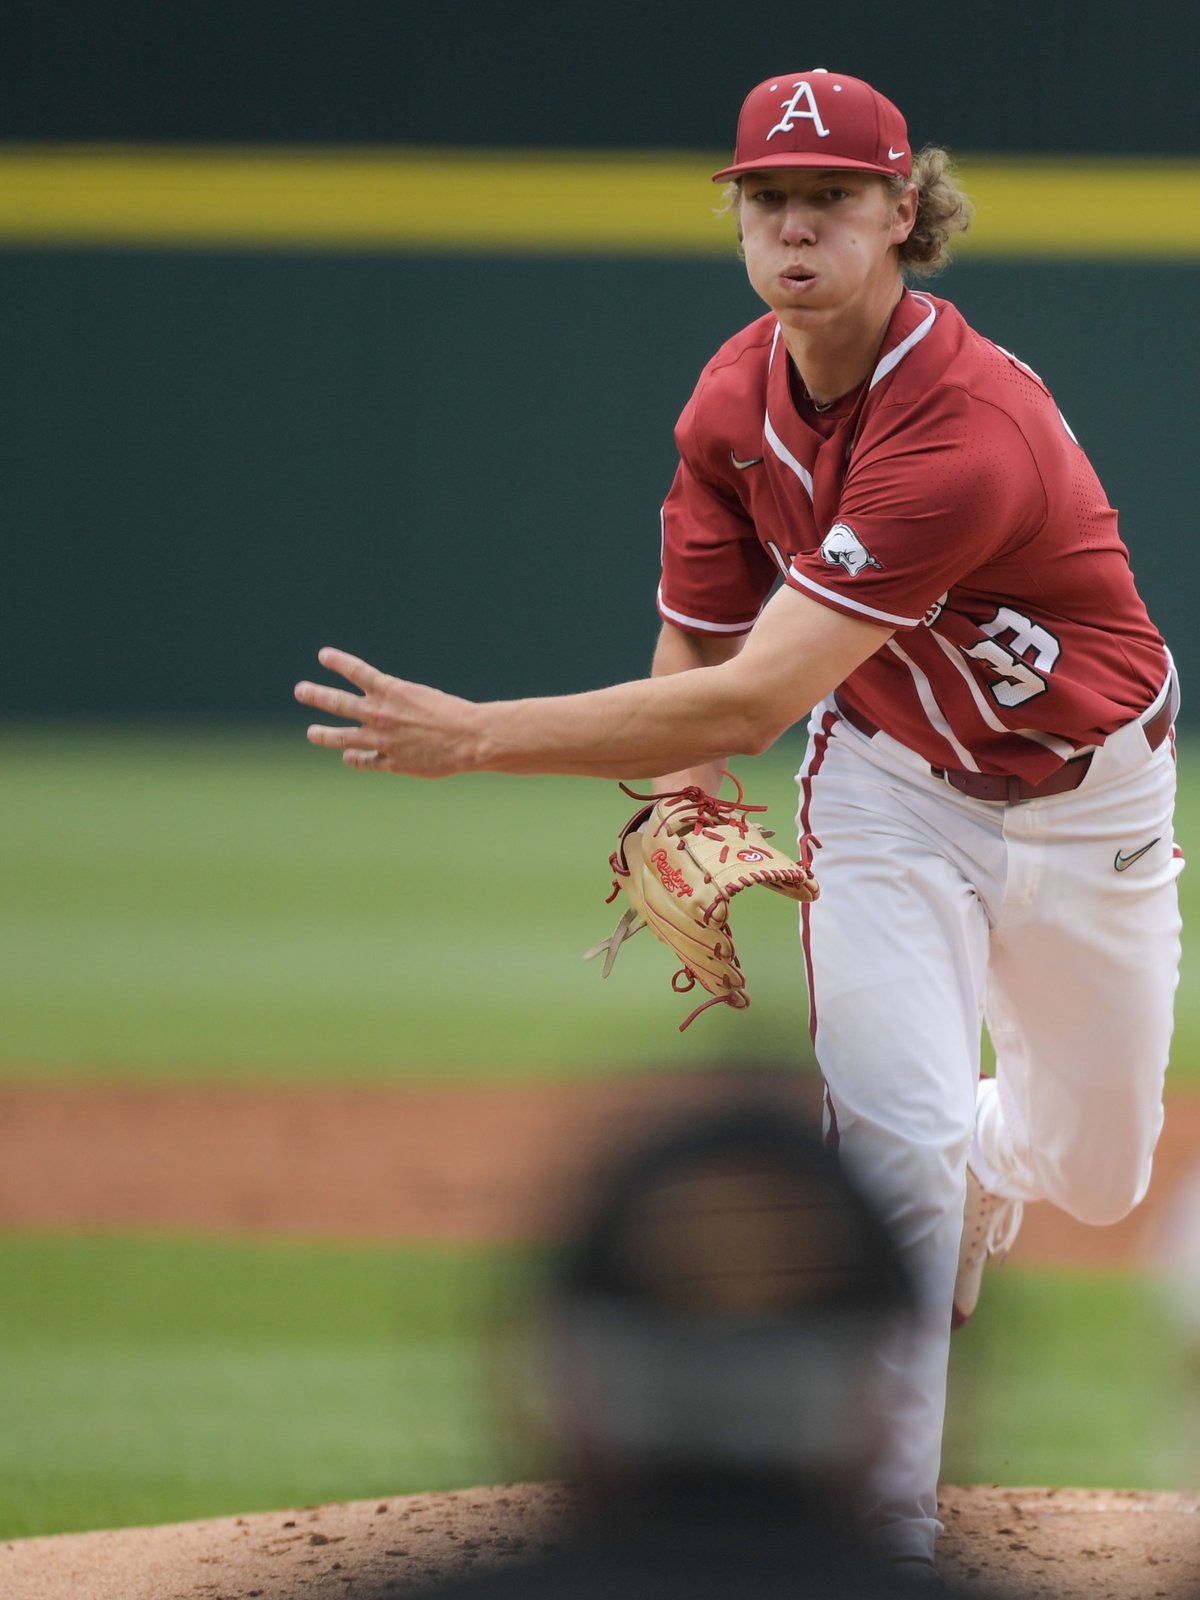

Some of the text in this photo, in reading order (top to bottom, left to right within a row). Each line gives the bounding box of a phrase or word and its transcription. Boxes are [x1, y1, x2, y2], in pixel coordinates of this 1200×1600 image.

[766, 80, 830, 141] A
[960, 605, 1062, 708] 33
[651, 848, 694, 897] Rawlings
